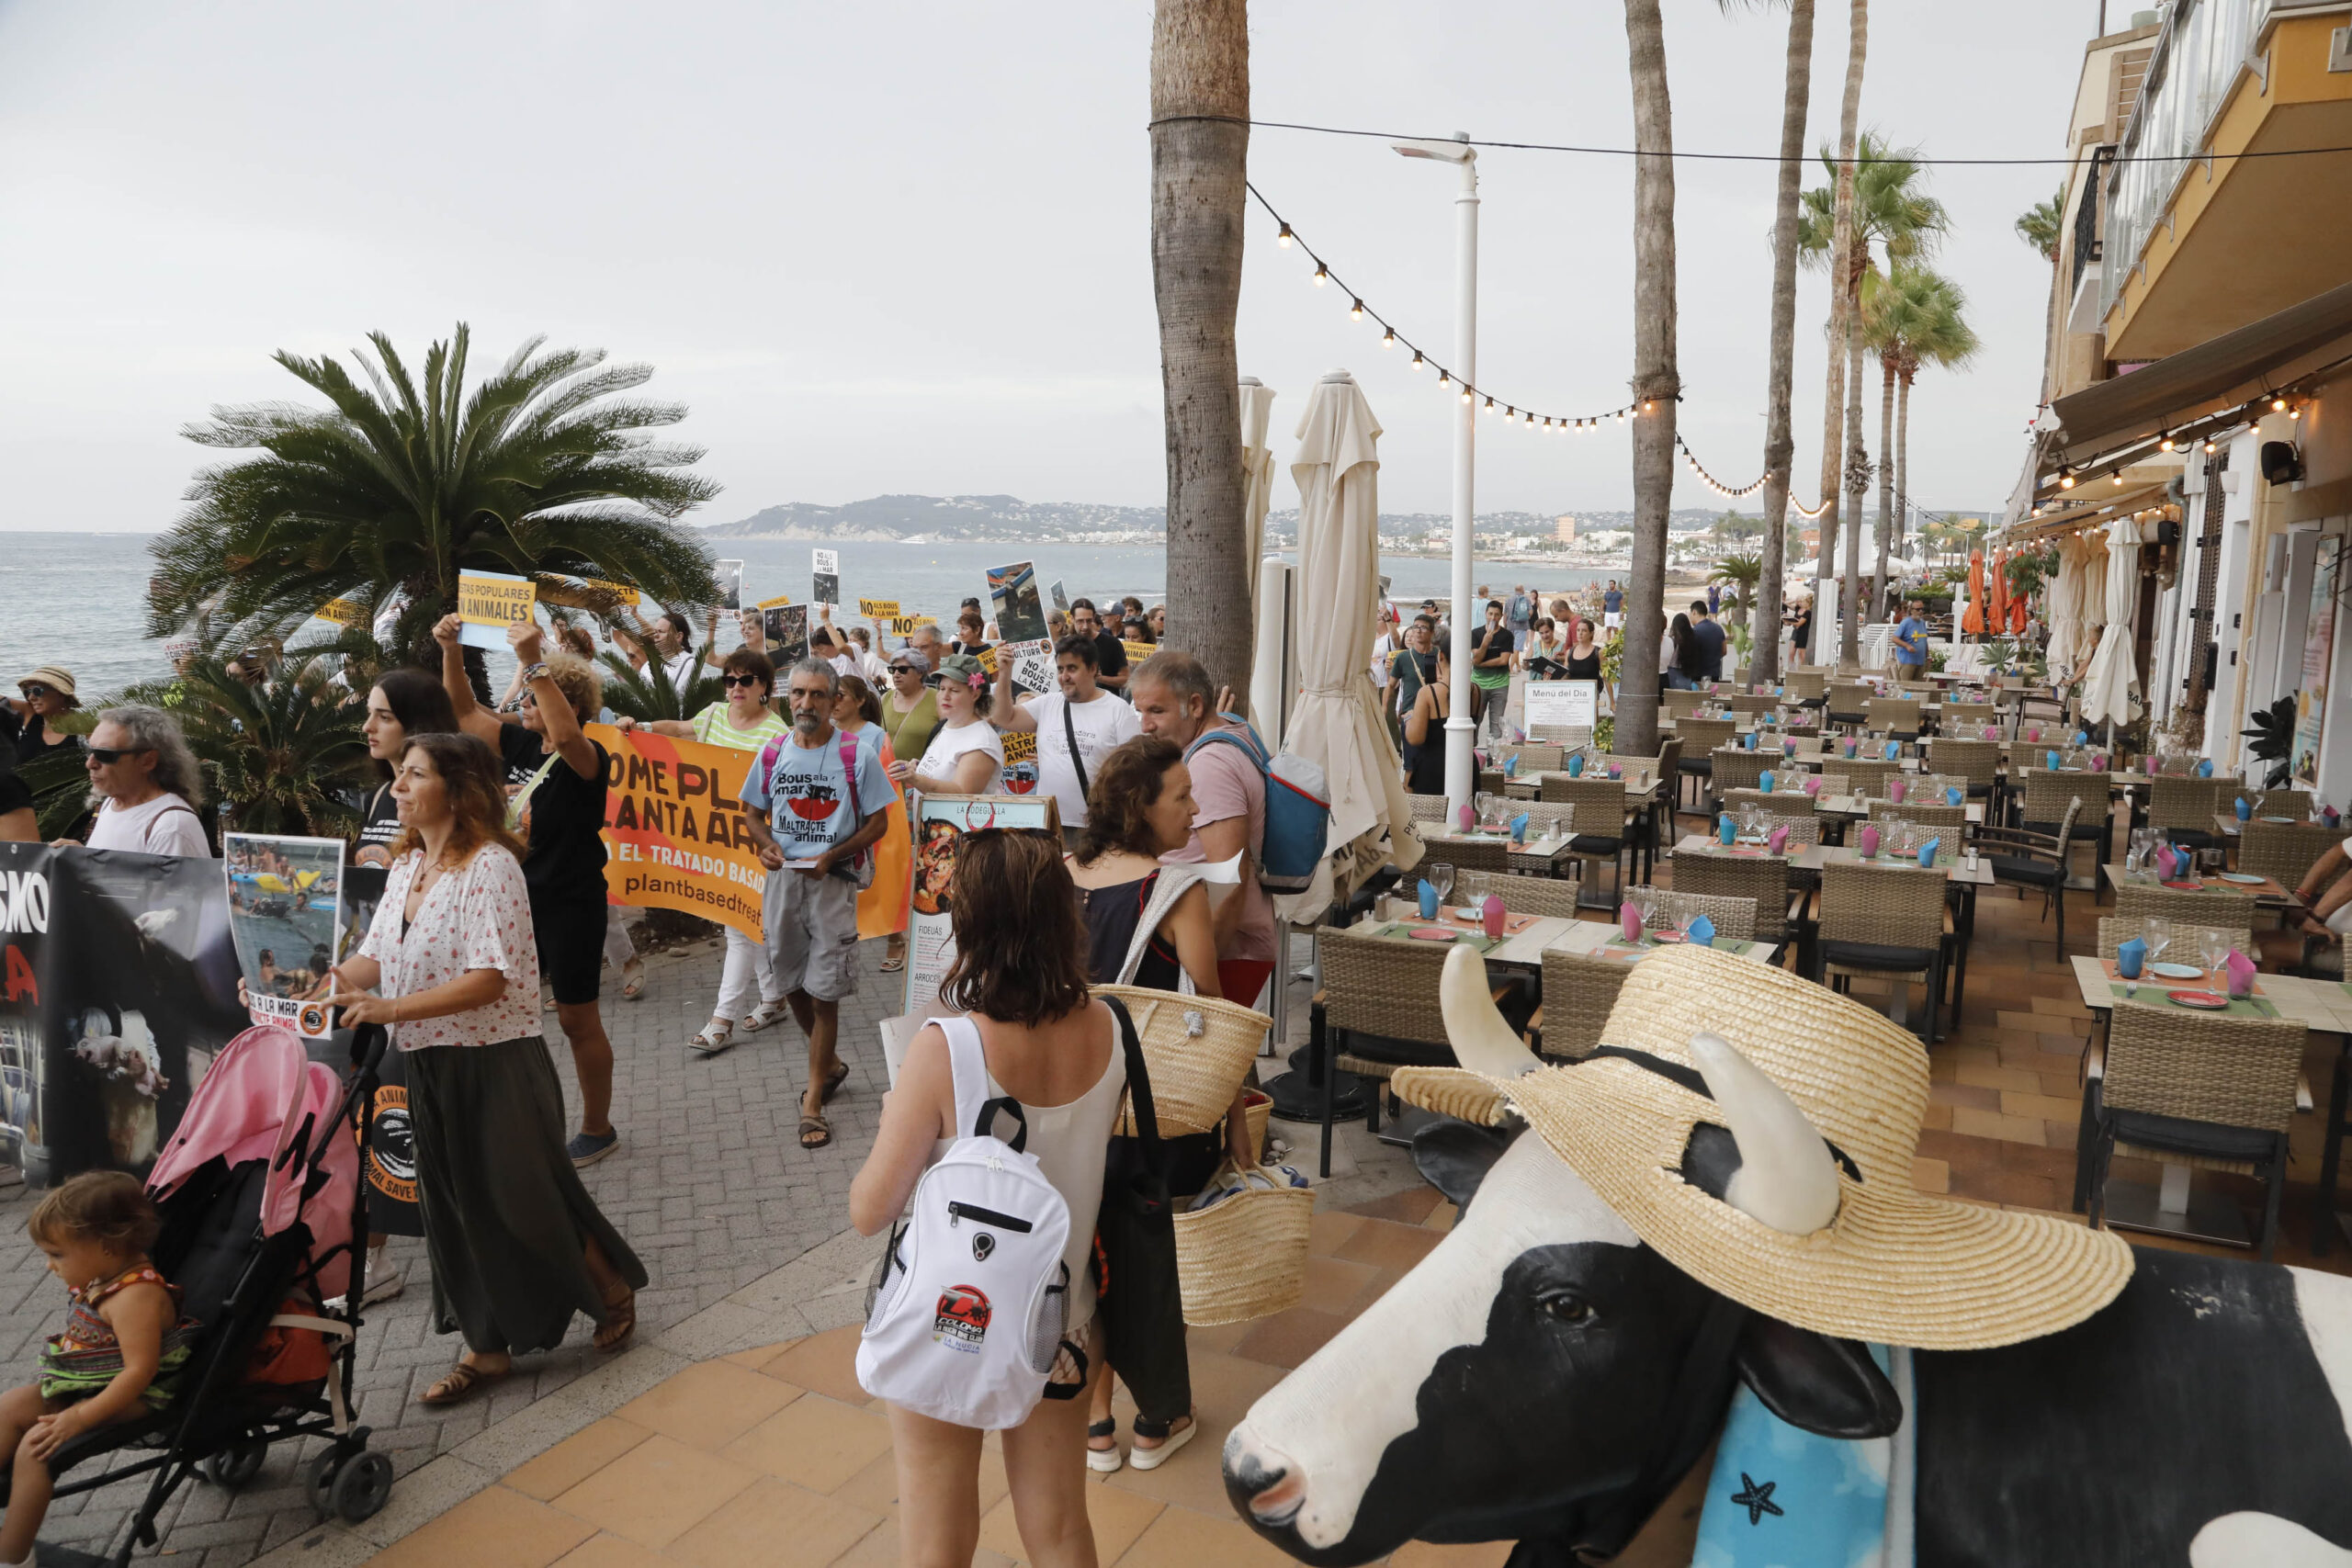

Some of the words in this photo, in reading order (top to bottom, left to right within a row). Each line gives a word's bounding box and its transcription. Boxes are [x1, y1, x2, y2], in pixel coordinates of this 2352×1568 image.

[476, 584, 530, 601] POPULARES
[467, 598, 528, 622] ANIMALES
[860, 600, 874, 616] NO
[892, 617, 913, 634] NO
[1013, 648, 1041, 659] ULTURA
[1022, 668, 1045, 683] BOUS
[1026, 660, 1039, 671] NO
[1039, 668, 1055, 680] ALS
[1018, 675, 1027, 685] LA
[1029, 681, 1048, 694] MAR
[1532, 689, 1556, 697] Menú
[778, 773, 812, 784] Bous
[676, 761, 750, 814] PL
[776, 784, 805, 795] mar
[967, 807, 1006, 816] BODEGULLA
[794, 831, 837, 843] animal
[619, 843, 643, 862] EL
[650, 844, 725, 878] TRATADO
[625, 873, 762, 927] plantbasedtreat
[918, 925, 943, 935] FIDEUÁS
[914, 973, 942, 984] ARROCES
[265, 998, 275, 1013] LA
[277, 1000, 299, 1017] MAR
[386, 1180, 413, 1199] SAVE
[938, 1318, 982, 1333] COLOMA
